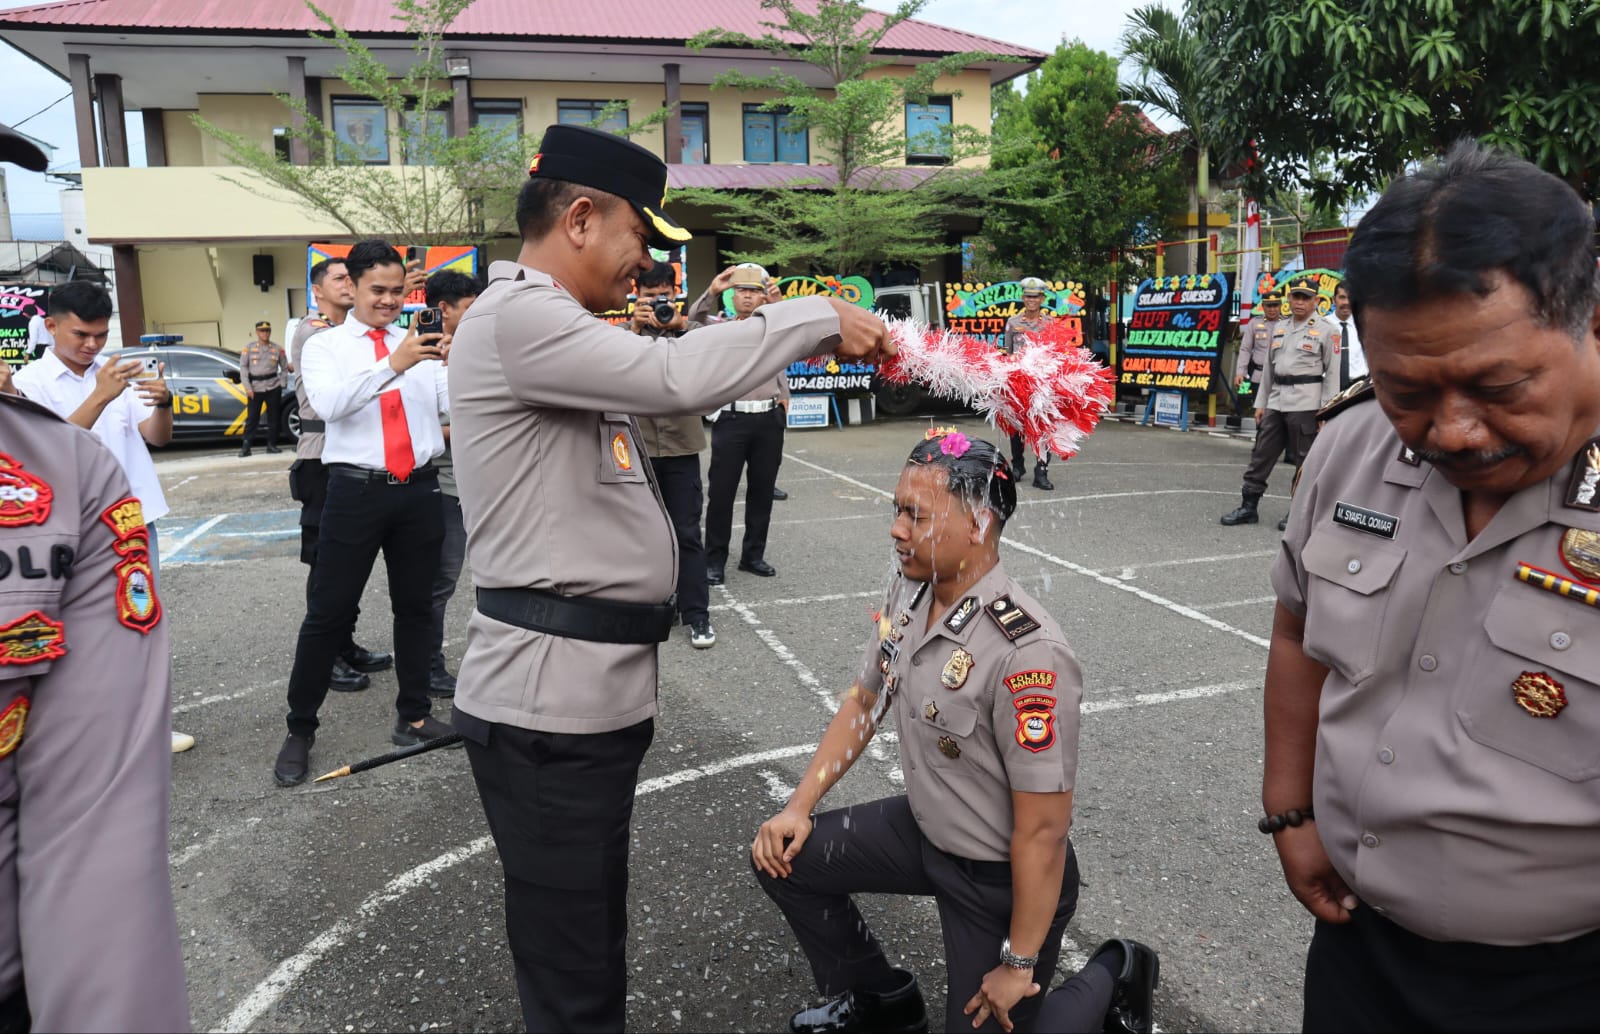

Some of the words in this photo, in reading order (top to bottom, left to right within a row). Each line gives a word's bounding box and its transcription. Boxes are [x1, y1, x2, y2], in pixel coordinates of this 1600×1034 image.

[1138, 292, 1175, 305] SELAMAT
[1180, 290, 1216, 303] SUKSES
[949, 318, 1004, 333] HUT
[1131, 311, 1170, 328] HUT
[1196, 310, 1221, 331] 79
[1184, 359, 1211, 375] DESA
[172, 393, 211, 415] ISI
[1368, 517, 1392, 532] QOMAR
[1010, 672, 1052, 686] POLRES
